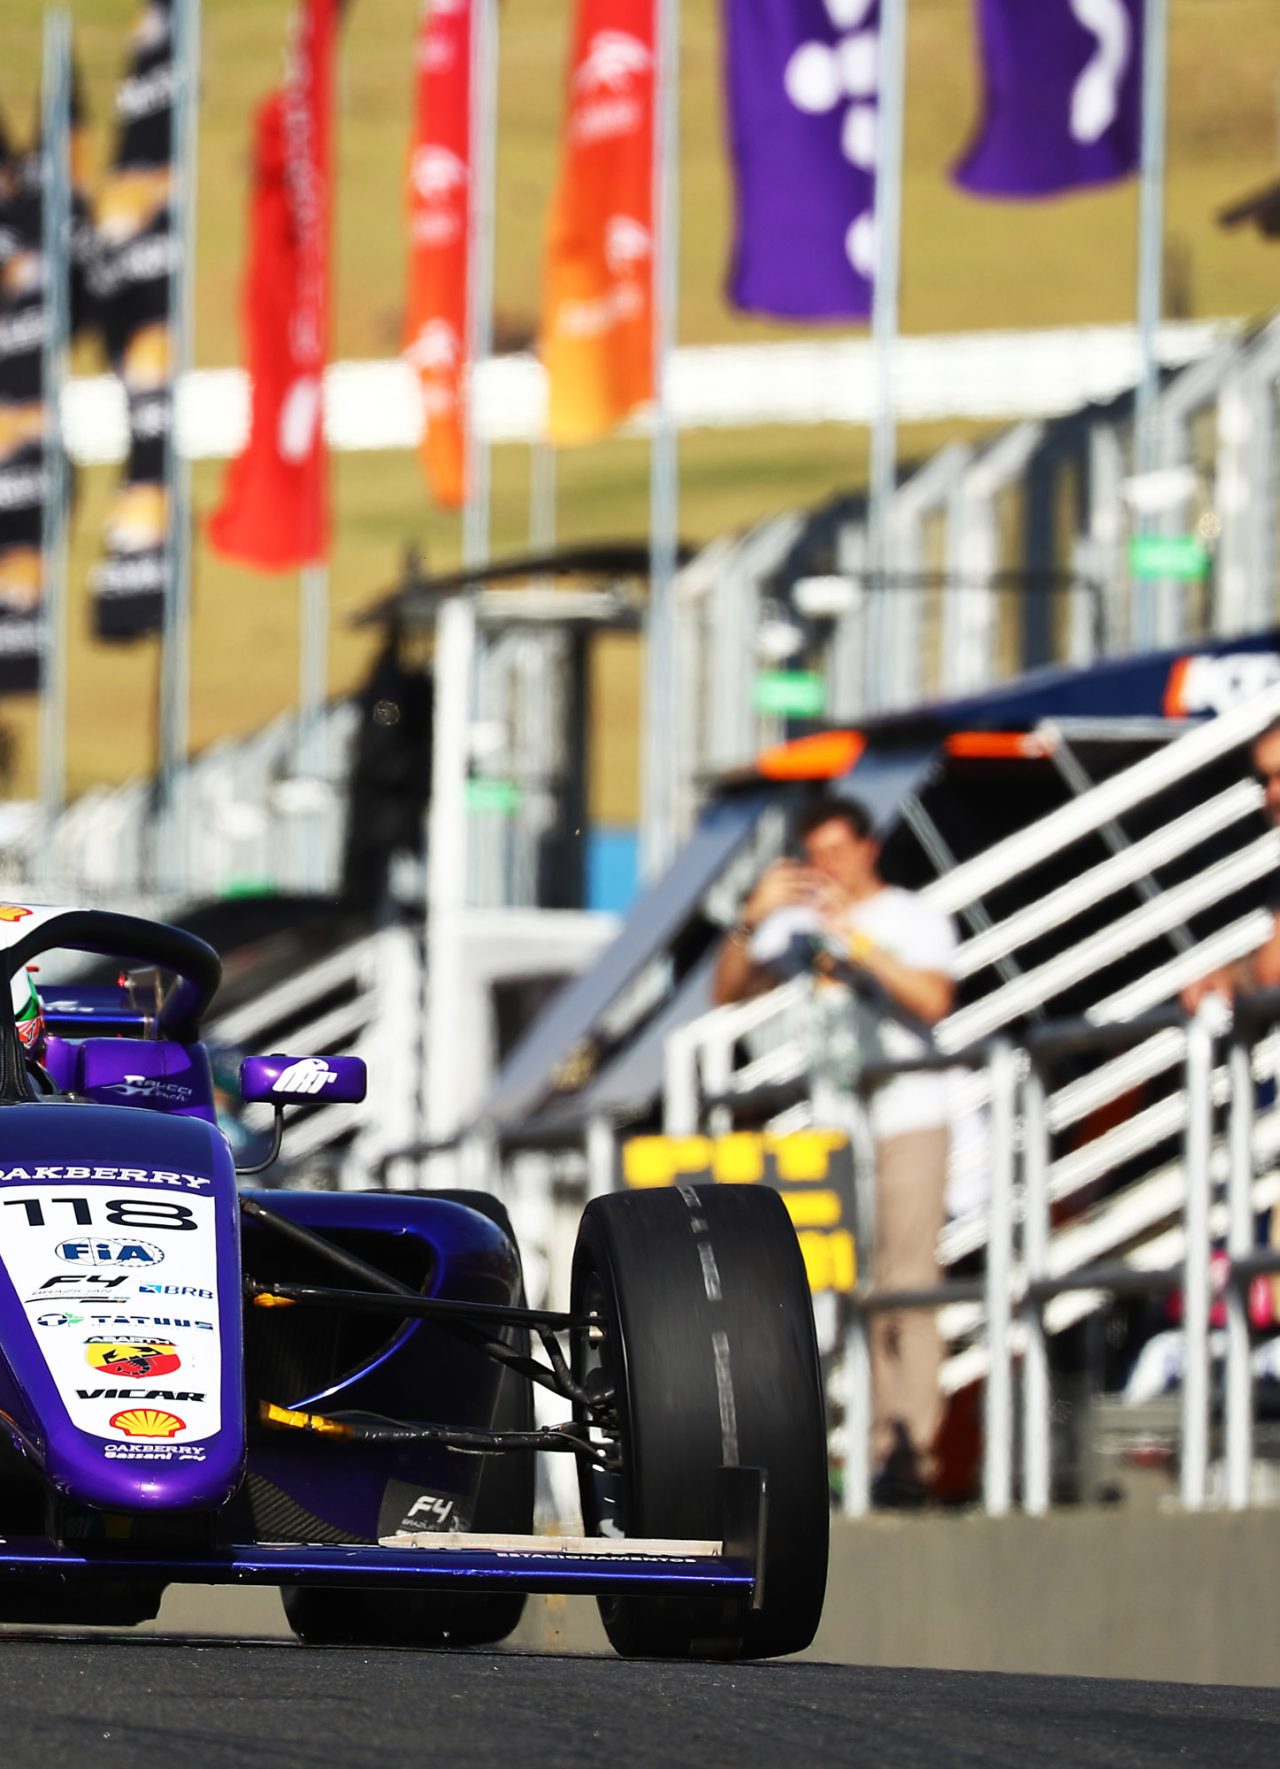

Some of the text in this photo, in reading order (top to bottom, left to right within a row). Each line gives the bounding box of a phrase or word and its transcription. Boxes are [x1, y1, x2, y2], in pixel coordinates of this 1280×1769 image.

[3, 1197, 199, 1231] 118
[39, 1275, 129, 1289] F4
[164, 1285, 214, 1299] BRB
[90, 1315, 214, 1330] TATUUS
[76, 1389, 207, 1402] VICAR
[104, 1444, 205, 1455] OAKBERRY
[407, 1495, 454, 1524] F4
[496, 1552, 696, 1562] ESTACIONAMENTOS
